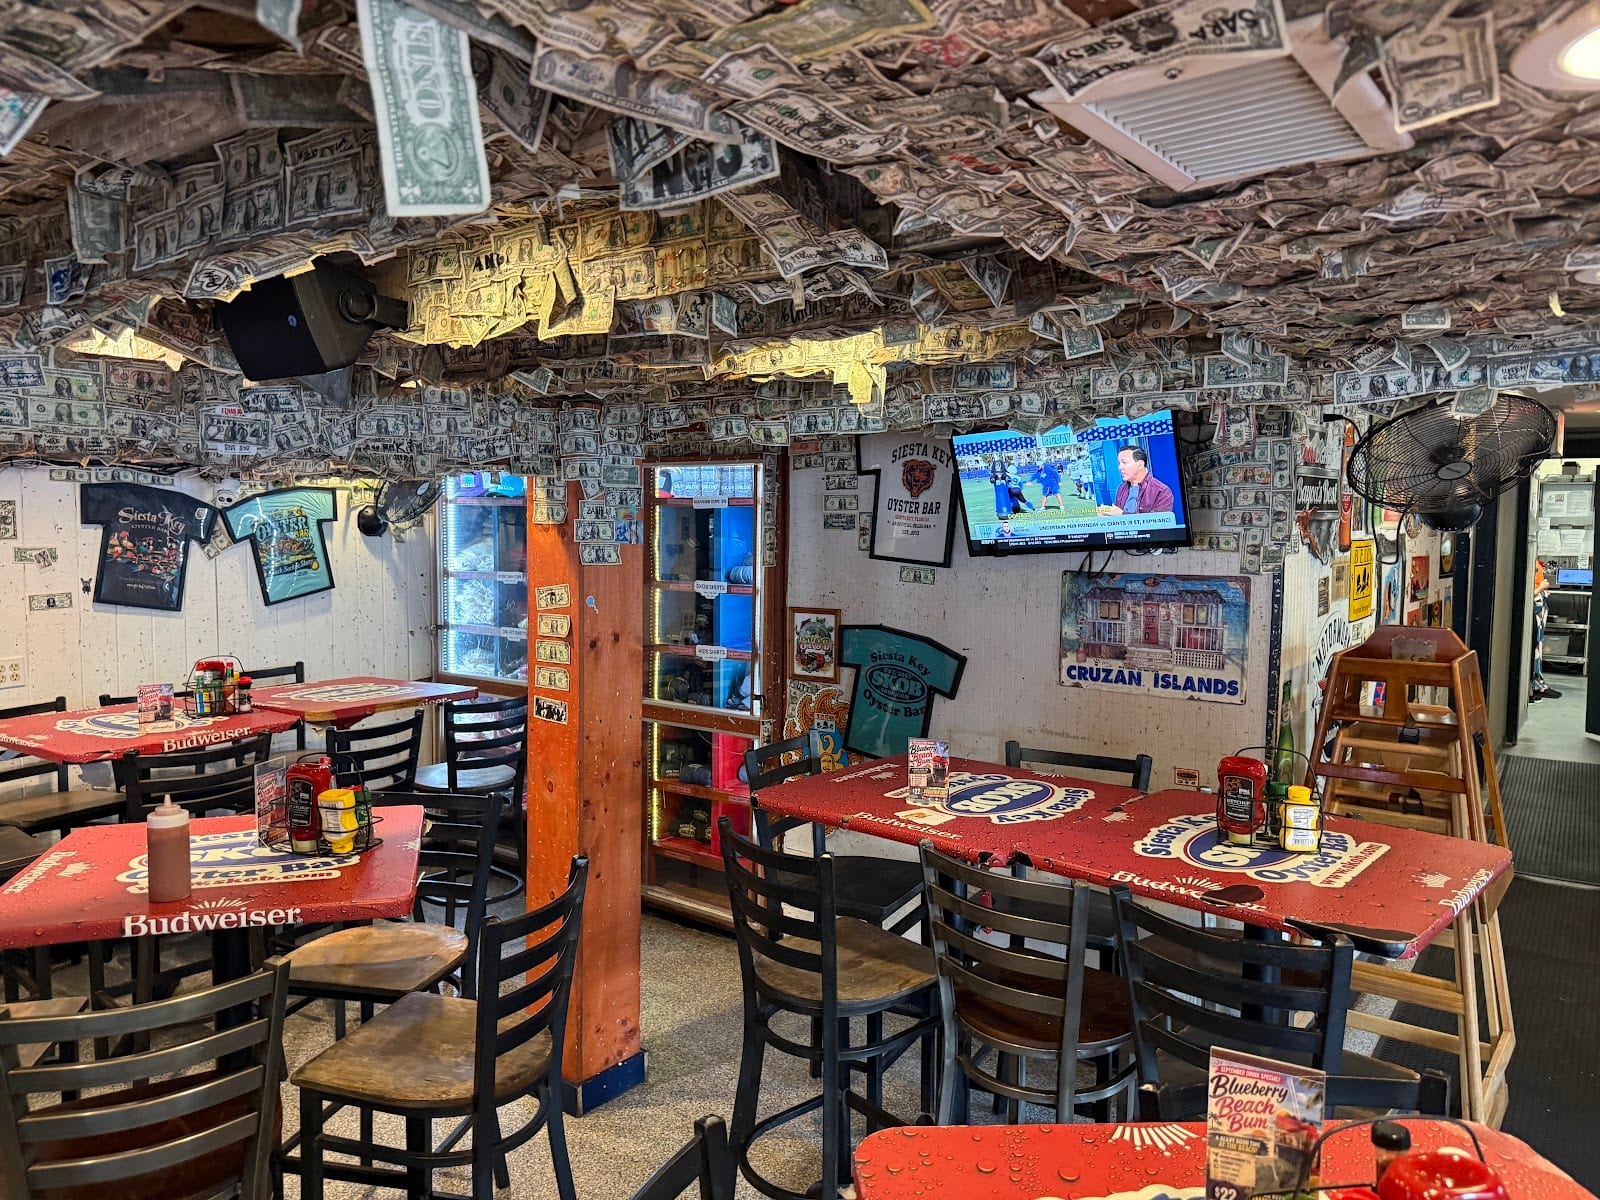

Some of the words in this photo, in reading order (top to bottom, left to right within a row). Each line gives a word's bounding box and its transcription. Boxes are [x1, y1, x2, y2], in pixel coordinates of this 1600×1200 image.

[403, 22, 442, 119] ONE
[891, 442, 928, 463] SIESTA
[931, 445, 953, 468] KEY
[118, 507, 158, 524] Siesta
[888, 498, 920, 515] OYSTER
[922, 501, 942, 515] BAR
[870, 652, 905, 662] Siesta
[908, 655, 930, 676] Key
[871, 671, 922, 697] SKOB
[1066, 664, 1142, 687] CRUZAN
[1153, 672, 1239, 696] ISLANDS
[904, 706, 926, 718] Bar
[163, 726, 251, 753] Budweiser
[951, 782, 1045, 813] SKOB
[1049, 788, 1089, 813] Siesta
[854, 811, 962, 840] Budweiser
[996, 809, 1048, 823] Key
[1141, 824, 1190, 857] Siesta
[1182, 815, 1217, 828] Ke
[126, 866, 267, 882] Oster
[281, 854, 357, 873] Bar
[1254, 851, 1343, 881] Oyster
[1320, 832, 1349, 853] Bar
[2, 851, 78, 895] Budweiser
[122, 905, 303, 938] Budweiser
[1220, 1066, 1246, 1076] SEPTEMBER
[1246, 1070, 1260, 1079] DRINK
[1261, 1072, 1281, 1083] SPECIAL!
[1209, 1074, 1288, 1103] Blueberry
[1215, 1096, 1275, 1118] Beach
[1227, 1113, 1269, 1133] Bum
[1227, 1142, 1237, 1150] THE
[1214, 1185, 1237, 1200] $22
